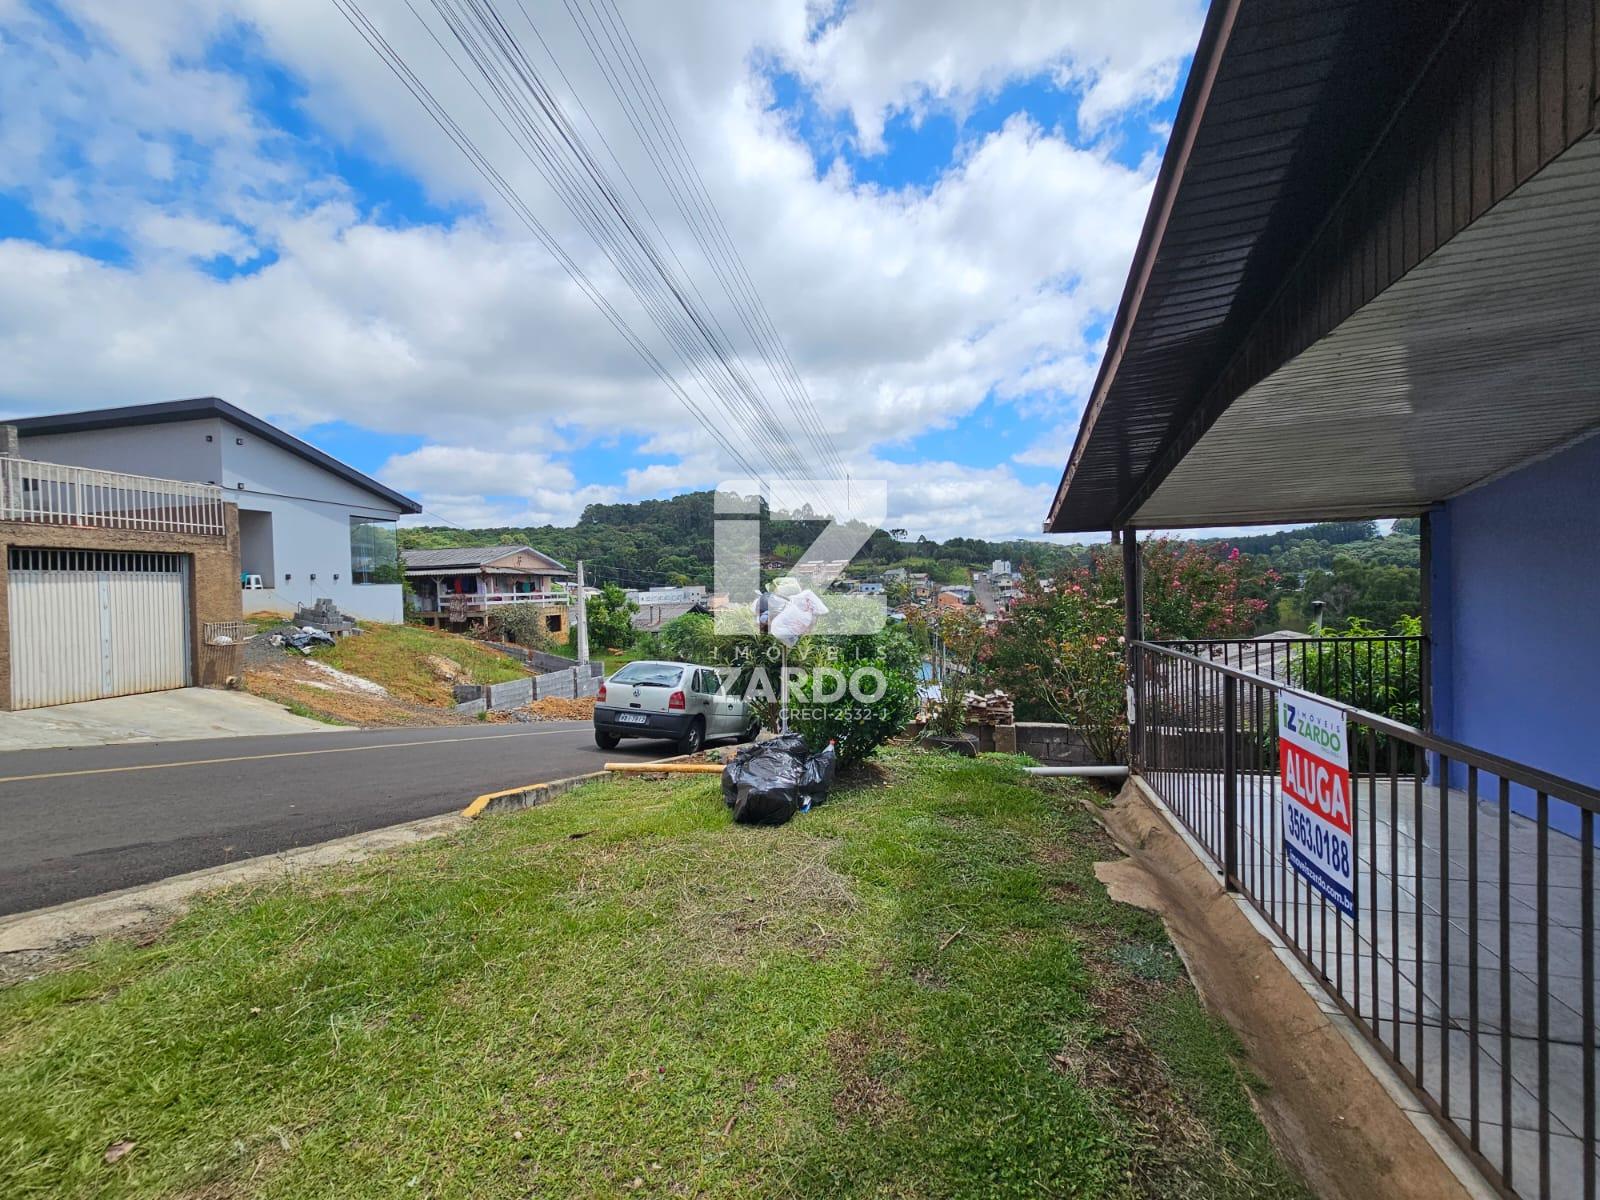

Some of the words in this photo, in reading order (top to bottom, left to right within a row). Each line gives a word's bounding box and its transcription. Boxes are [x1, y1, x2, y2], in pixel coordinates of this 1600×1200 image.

[1298, 719, 1341, 752] ZARDO
[1286, 749, 1349, 826] ALUGA
[1287, 803, 1350, 879] 3563.0188
